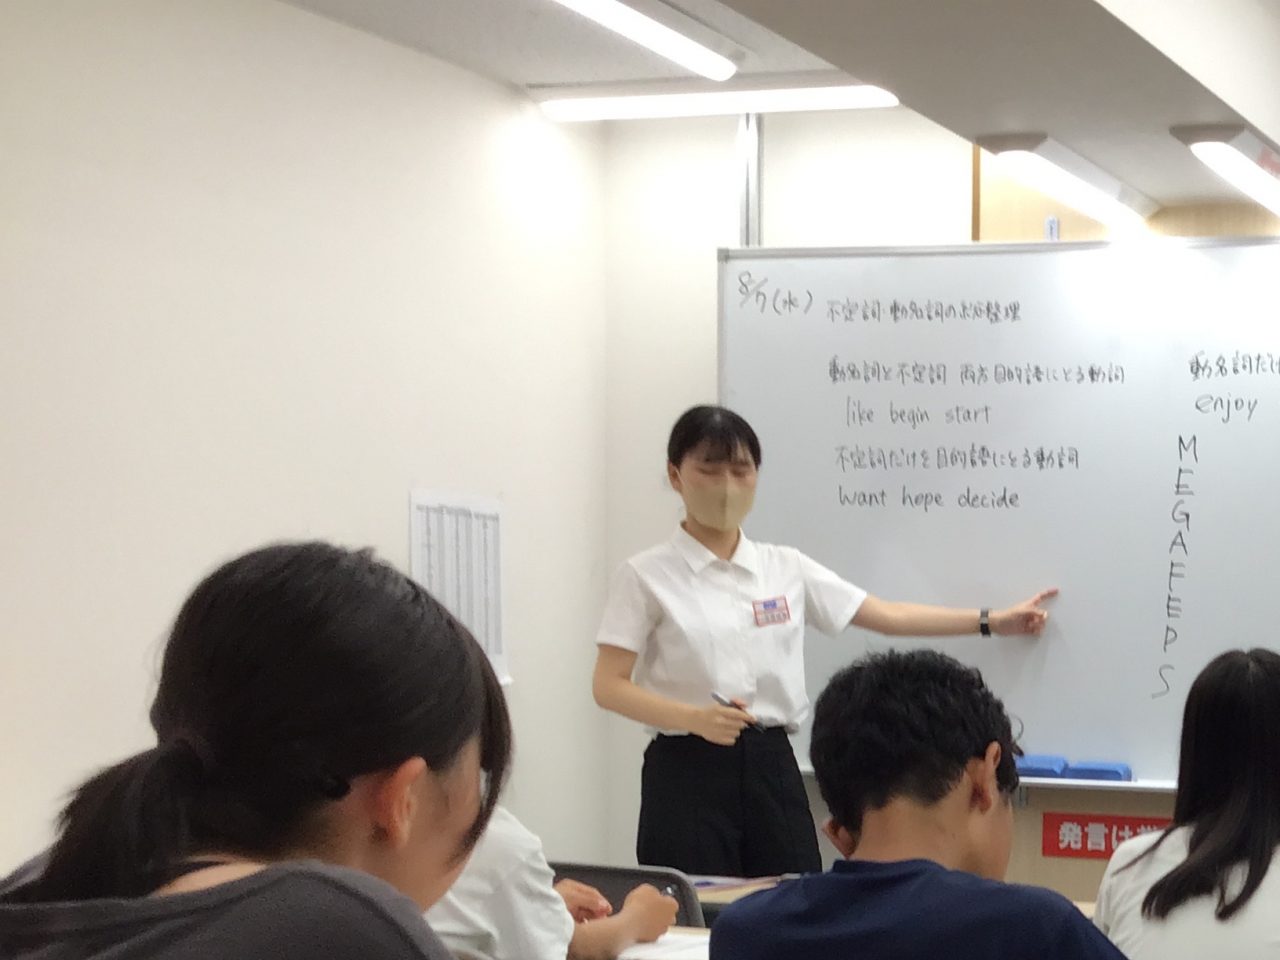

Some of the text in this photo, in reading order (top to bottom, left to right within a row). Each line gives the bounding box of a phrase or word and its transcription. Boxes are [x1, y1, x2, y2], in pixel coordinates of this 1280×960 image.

[846, 396, 992, 430] like begin start
[1194, 391, 1259, 425] enjoy
[901, 484, 945, 513] hope
[957, 486, 1021, 509] decide
[1059, 820, 1160, 852] 発言は
